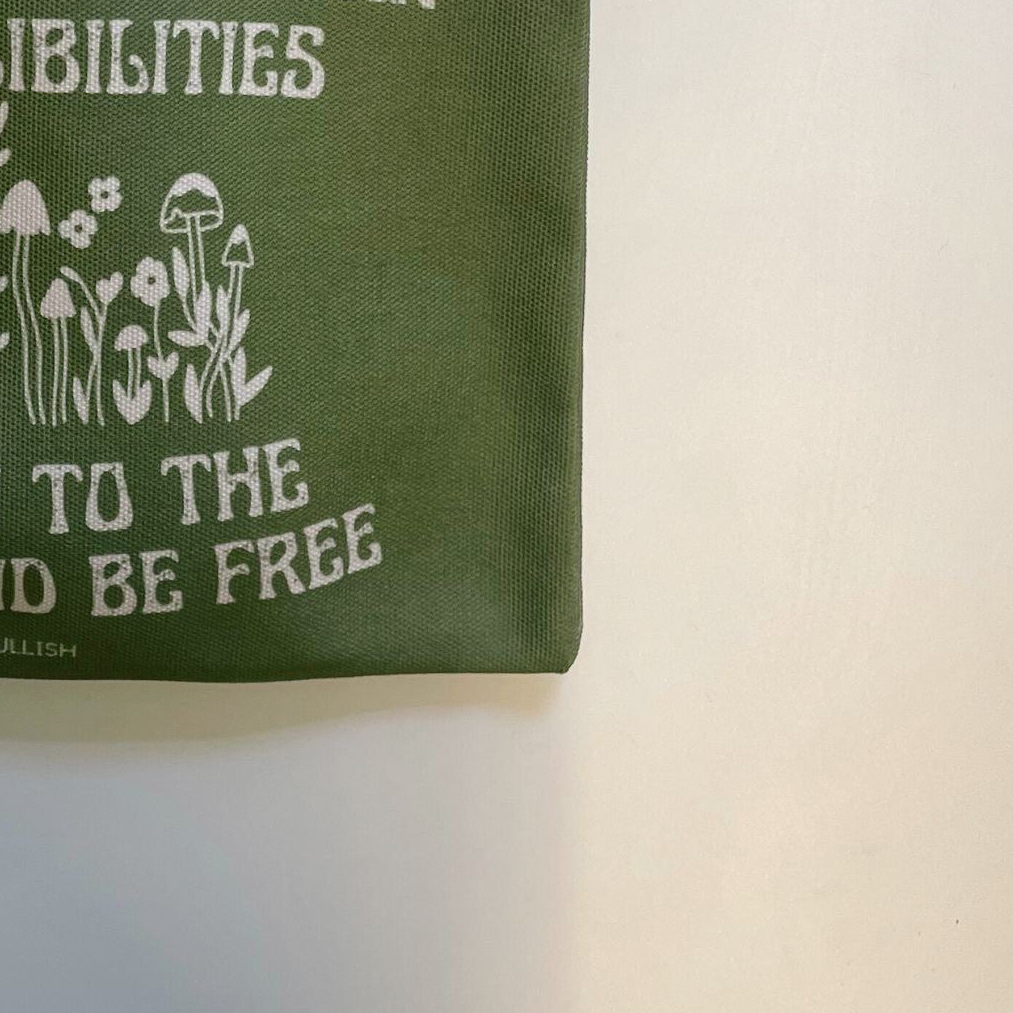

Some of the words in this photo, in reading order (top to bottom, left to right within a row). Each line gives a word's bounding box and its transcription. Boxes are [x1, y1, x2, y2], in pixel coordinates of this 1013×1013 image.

[31, 461, 134, 535] TO
[160, 437, 310, 526] THE
[88, 549, 183, 617] BE
[213, 502, 384, 606] FREE
